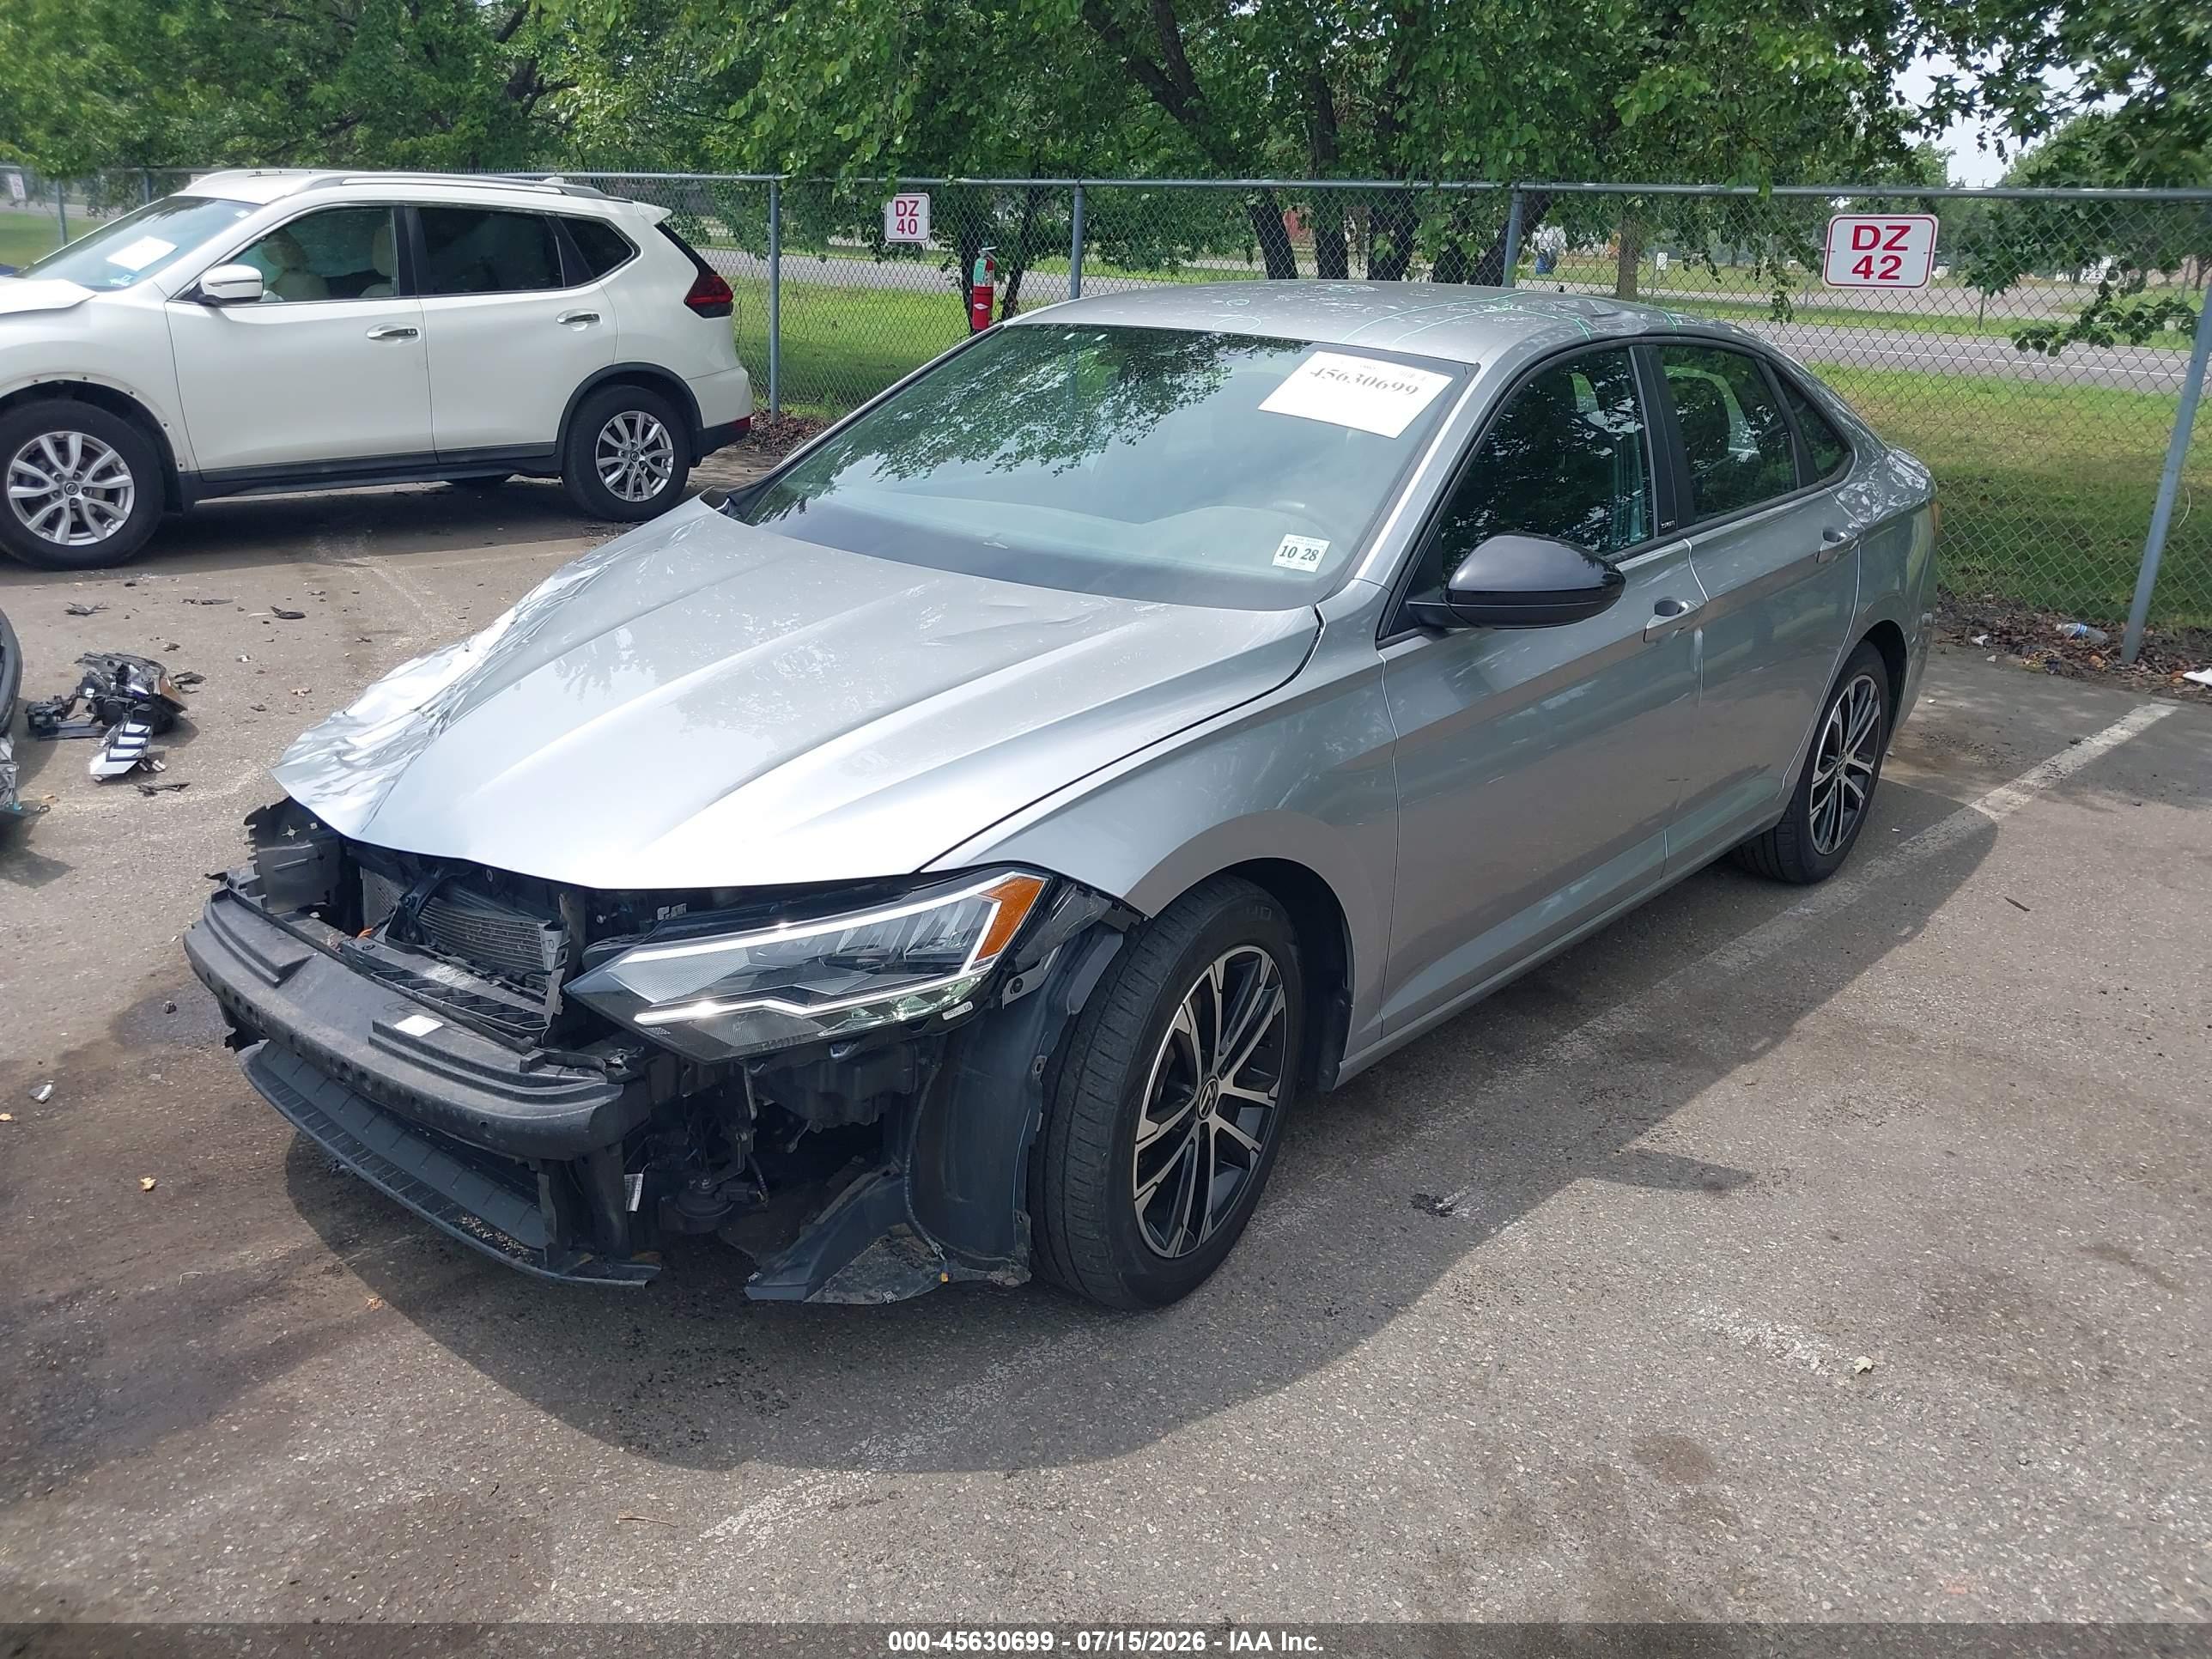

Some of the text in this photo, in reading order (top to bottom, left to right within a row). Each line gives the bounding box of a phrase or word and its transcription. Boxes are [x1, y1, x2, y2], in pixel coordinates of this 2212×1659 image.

[896, 200, 920, 216] DZ
[896, 218, 918, 235] 40
[1851, 225, 1911, 251] DZ
[1851, 255, 1902, 280] 42
[1310, 367, 1419, 395] 45630699
[1279, 545, 1319, 562] 10 28
